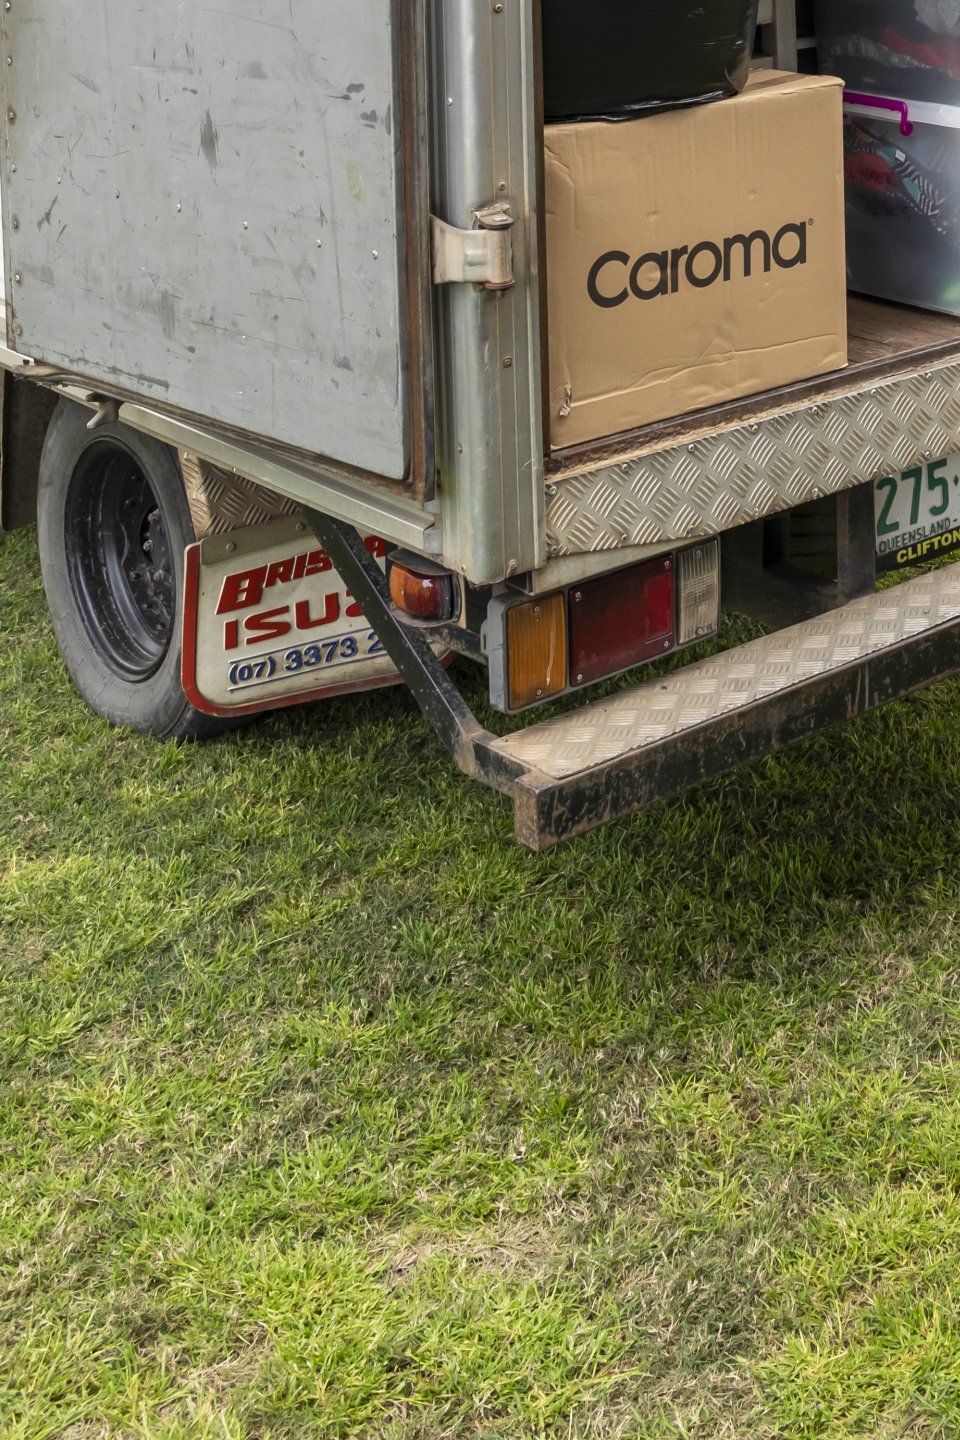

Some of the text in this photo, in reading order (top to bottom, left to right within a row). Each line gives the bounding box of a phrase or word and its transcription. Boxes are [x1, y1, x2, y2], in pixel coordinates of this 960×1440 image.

[878, 517, 951, 554] QUEENSLAND
[228, 654, 276, 685] (07)
[283, 634, 358, 673] 3373
